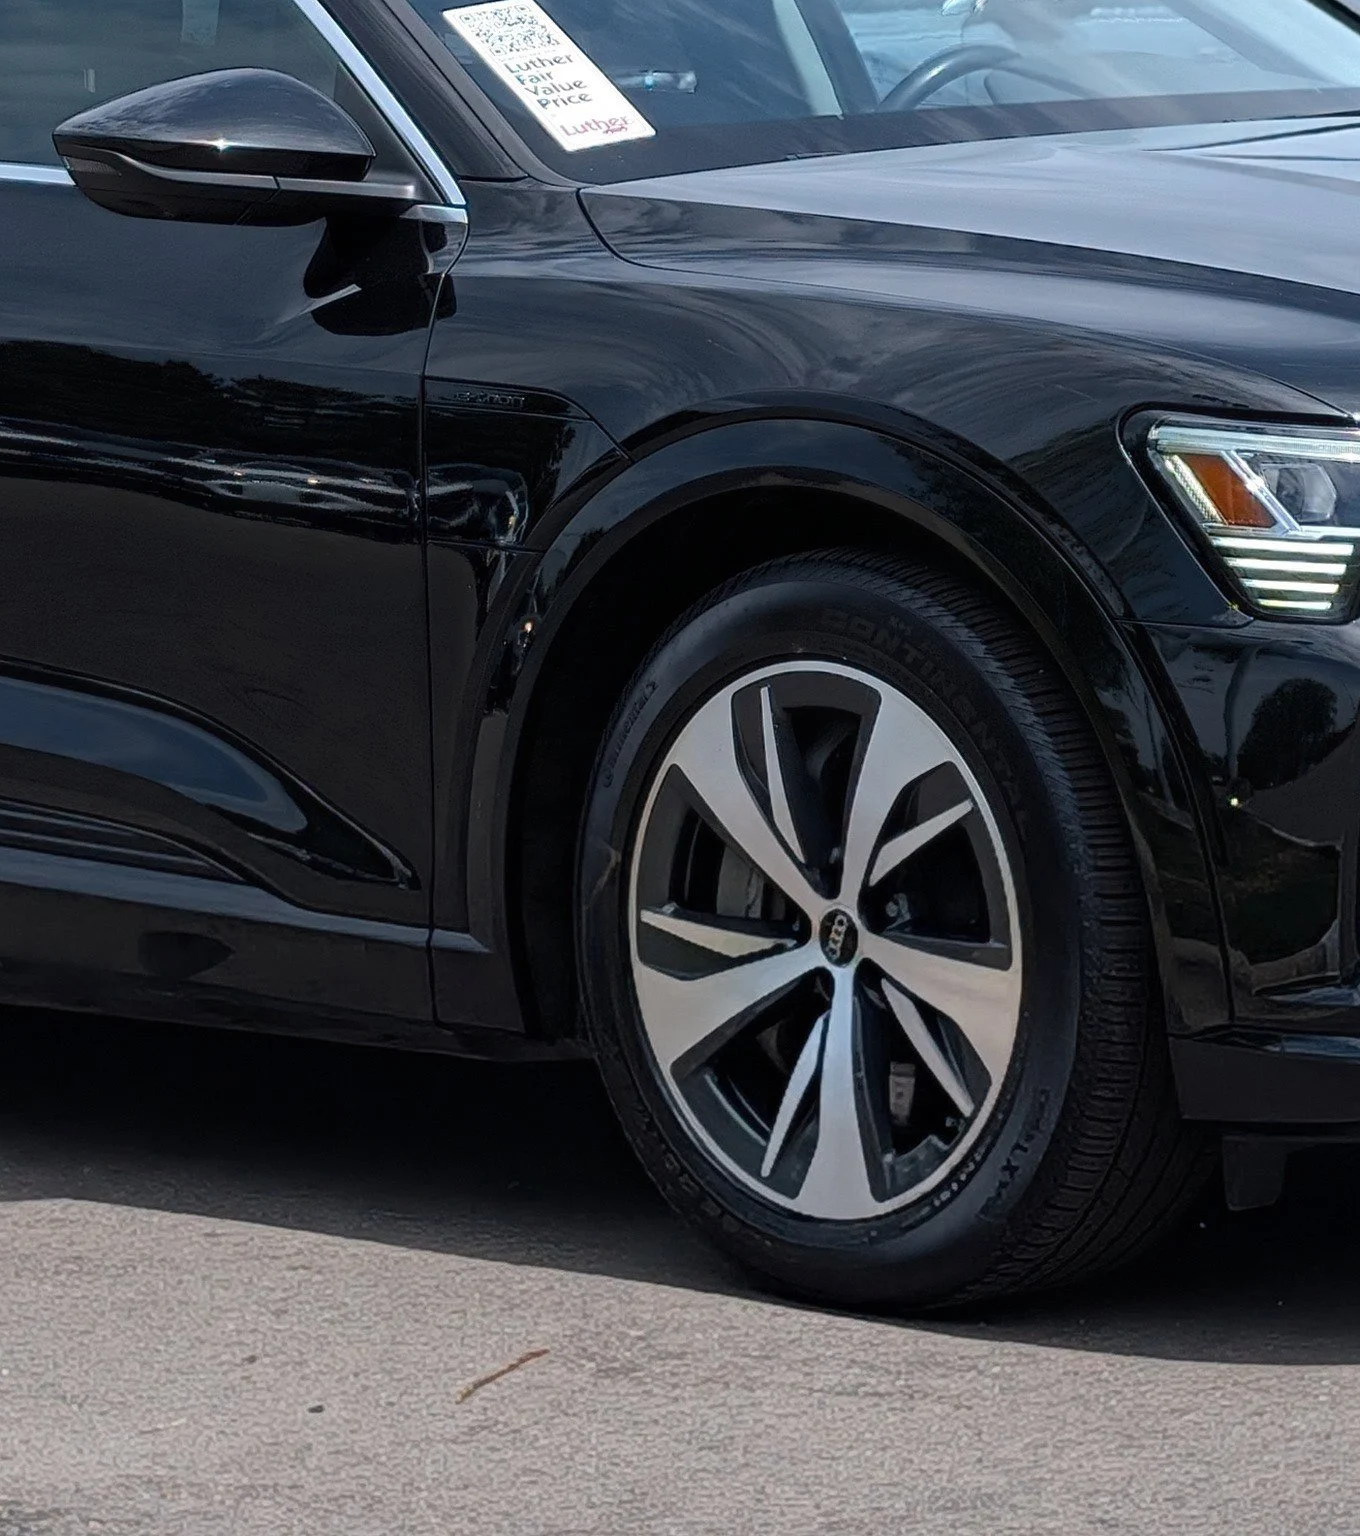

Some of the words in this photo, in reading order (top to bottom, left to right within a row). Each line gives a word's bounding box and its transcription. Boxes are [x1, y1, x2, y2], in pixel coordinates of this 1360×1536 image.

[504, 53, 574, 74] Luther
[515, 70, 554, 86] Fair
[524, 79, 588, 97] Value
[537, 92, 593, 110] Price
[560, 115, 632, 136] Luther
